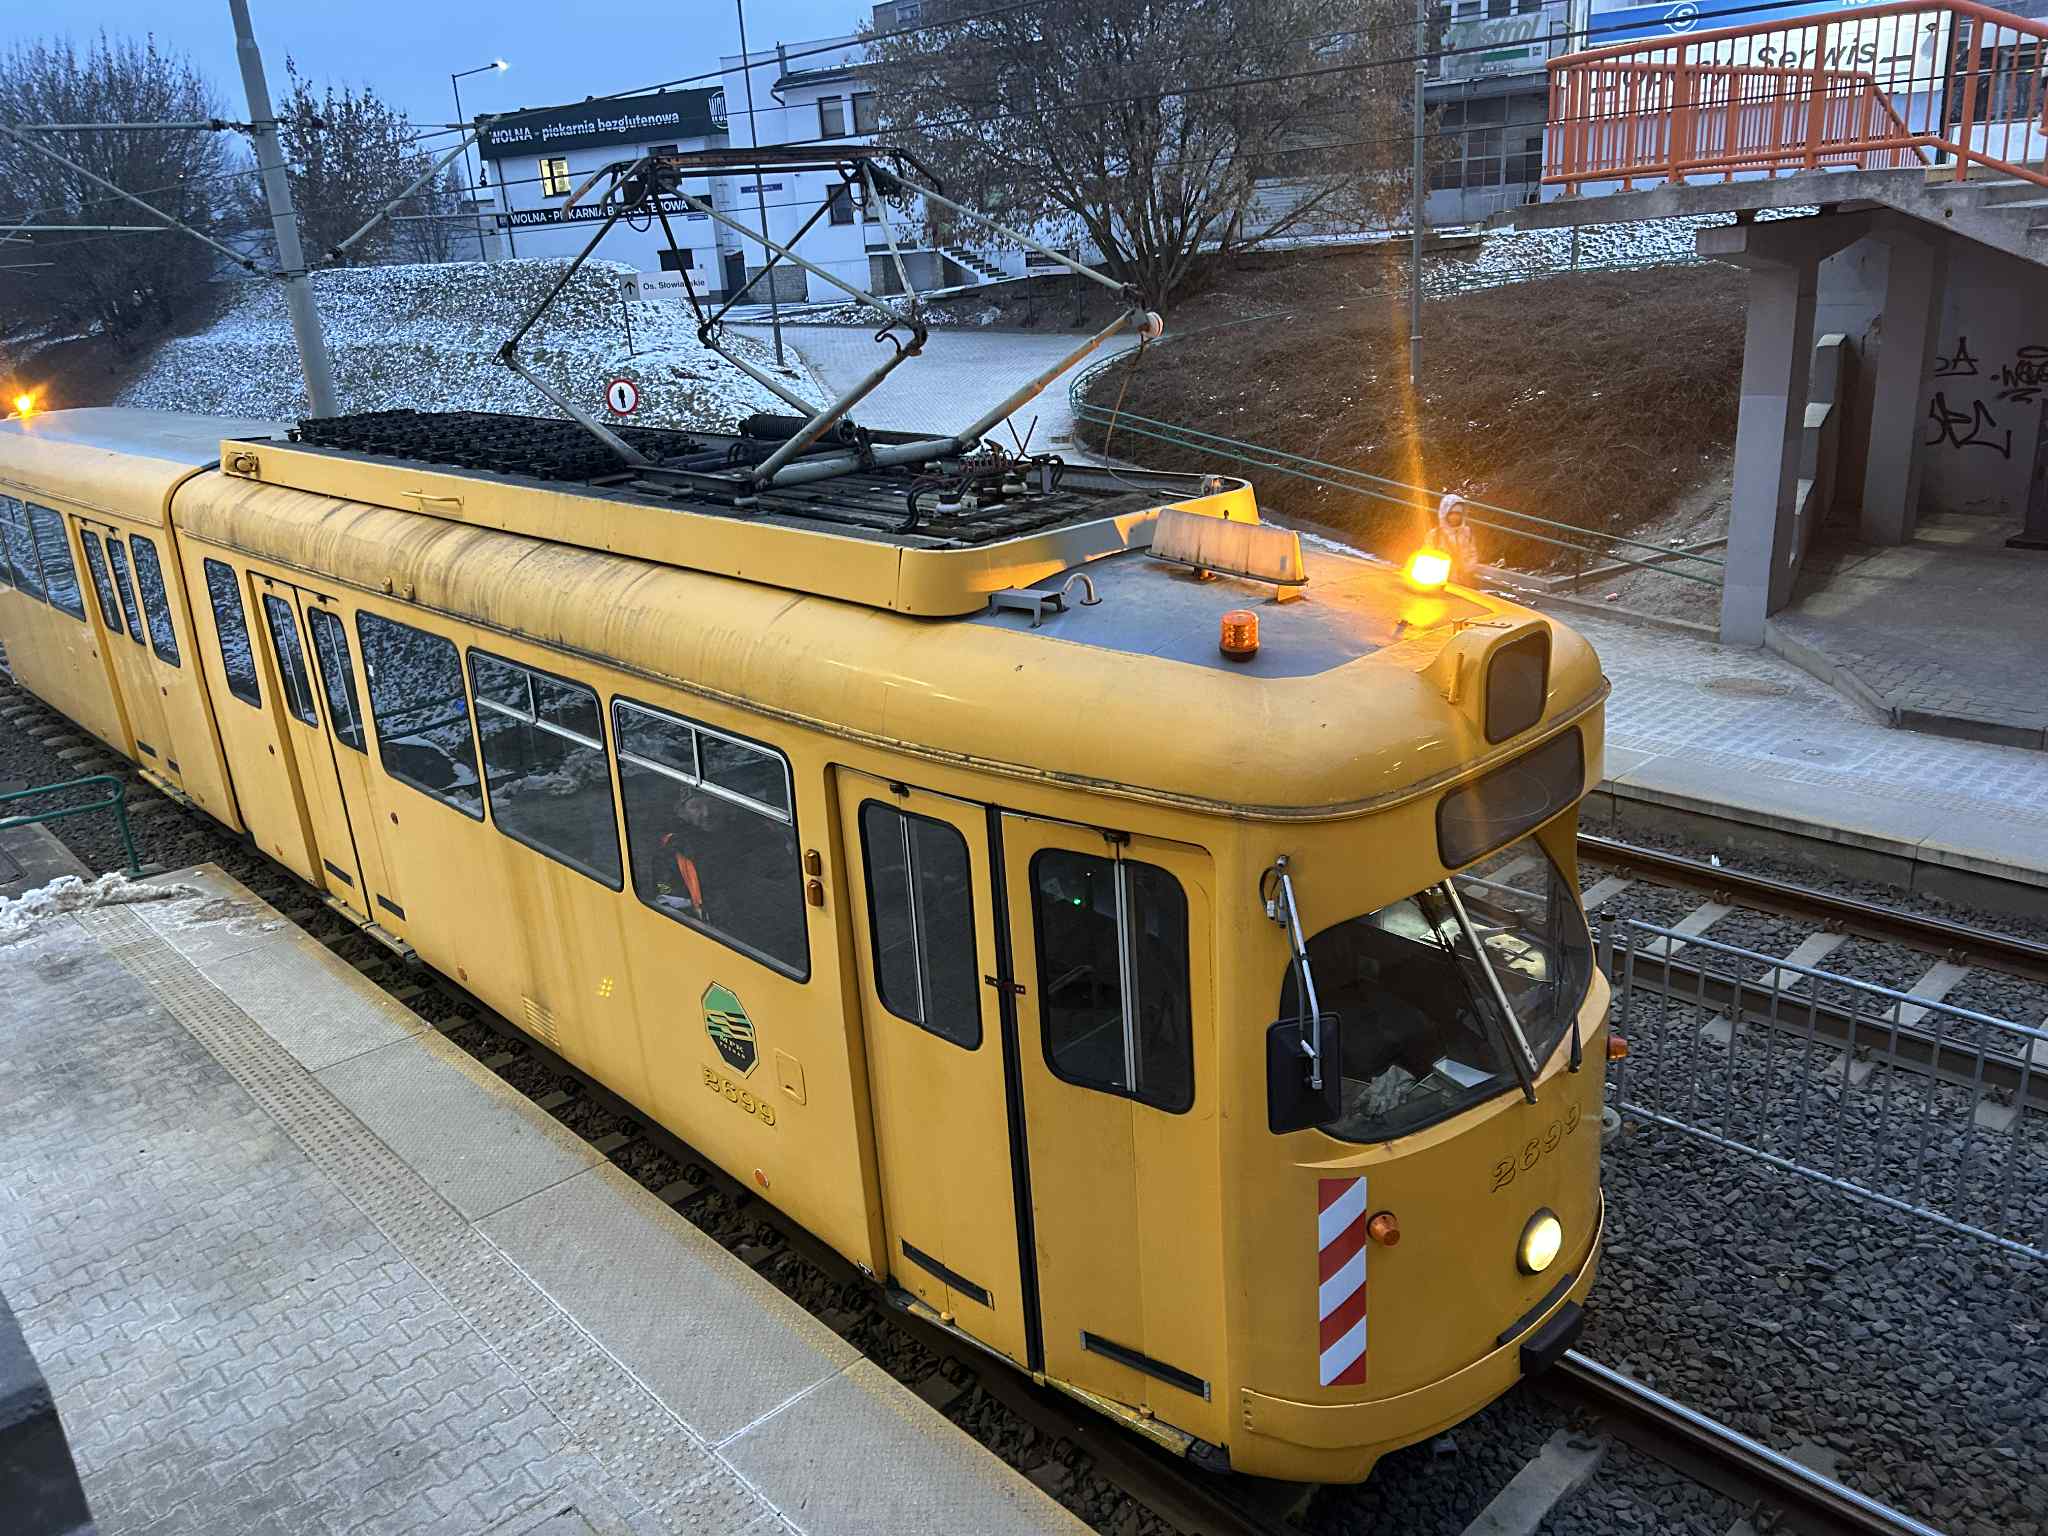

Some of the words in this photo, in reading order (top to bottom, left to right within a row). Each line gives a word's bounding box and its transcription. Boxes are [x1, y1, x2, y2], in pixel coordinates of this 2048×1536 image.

[490, 126, 533, 144] WOLNA
[542, 120, 596, 141] piekarnia
[597, 111, 680, 133] bezglutenowa
[511, 213, 547, 225] WOLNA
[554, 207, 606, 221] PIKARNIA
[658, 279, 705, 289] Słowiakie
[703, 1067, 776, 1127] 2699
[1492, 1099, 1582, 1193] 2699
